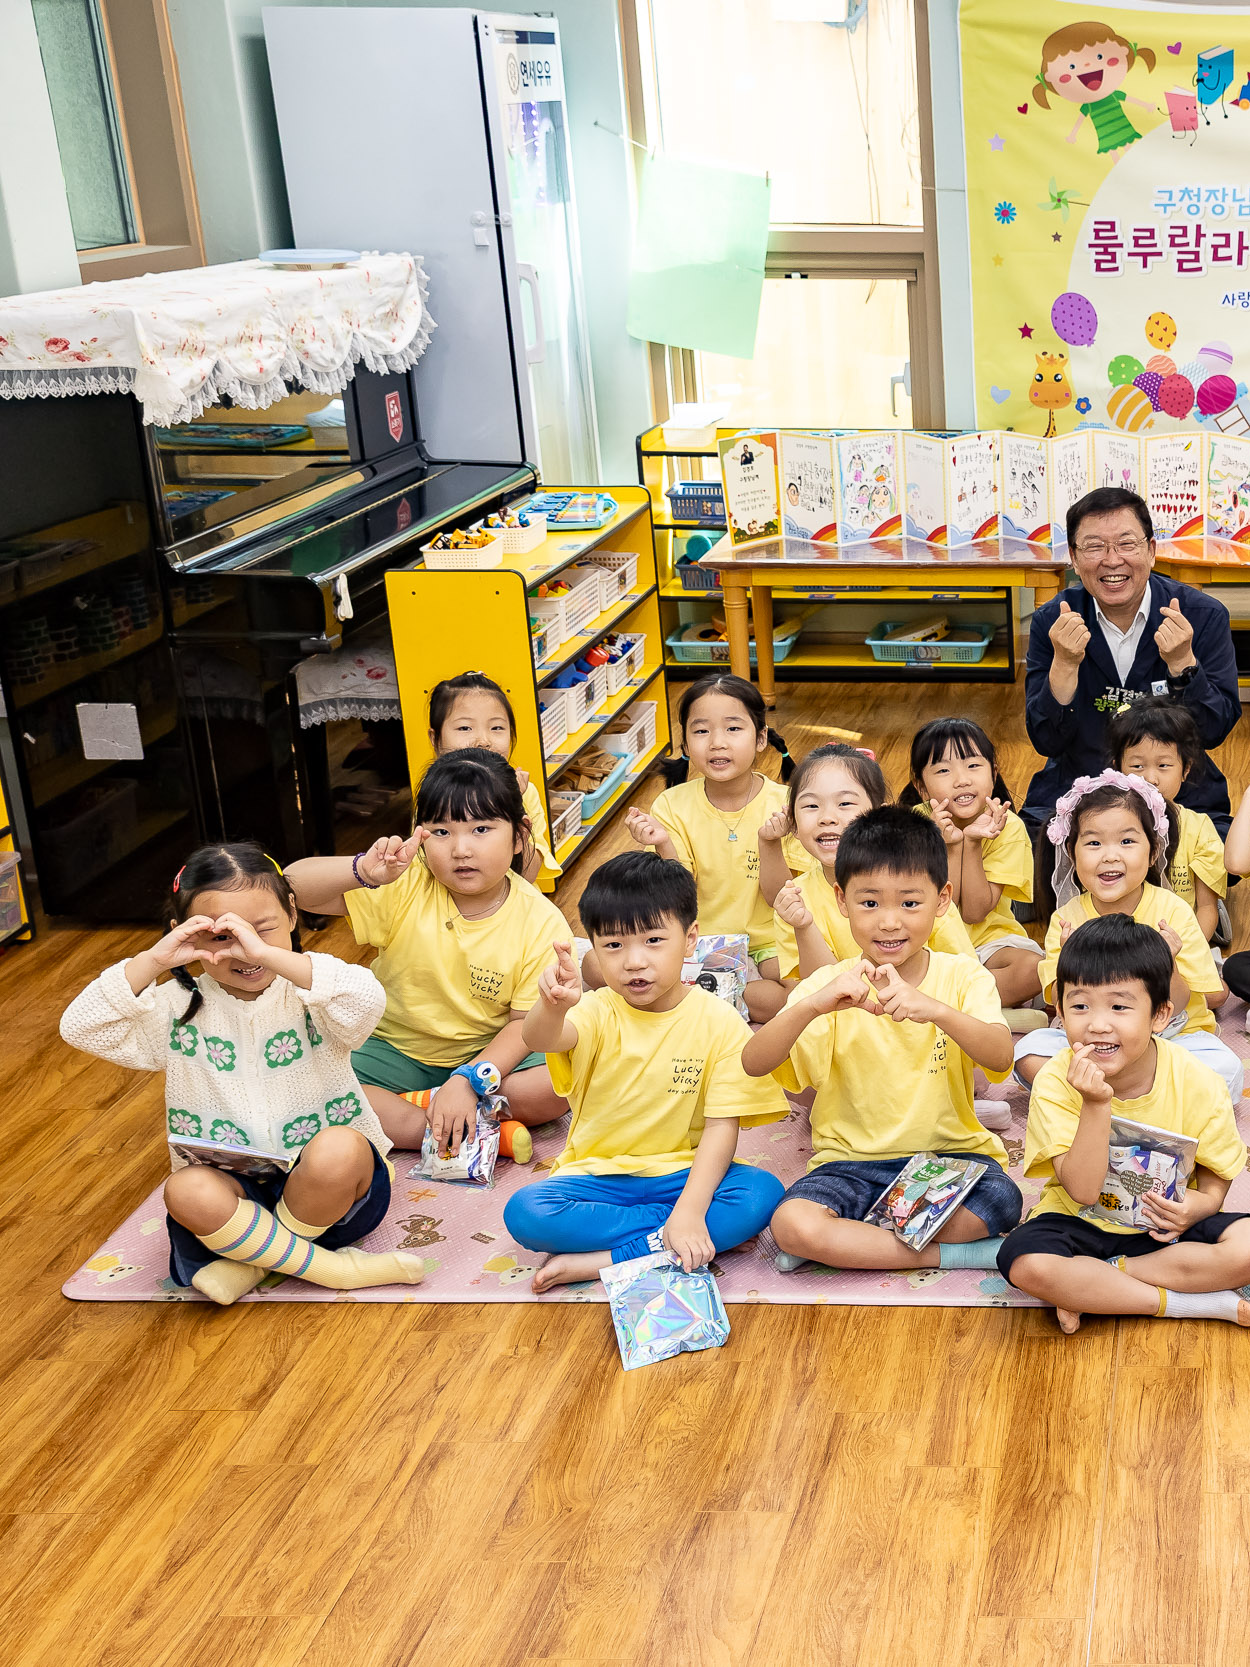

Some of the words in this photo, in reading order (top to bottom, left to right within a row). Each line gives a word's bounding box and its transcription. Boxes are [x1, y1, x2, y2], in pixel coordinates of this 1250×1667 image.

[520, 60, 552, 88] 연세우유
[1088, 220, 1250, 273] 룰루랄라
[470, 979, 501, 997] Vicky
[471, 971, 503, 989] Lucky
[674, 1065, 703, 1077] Lucy
